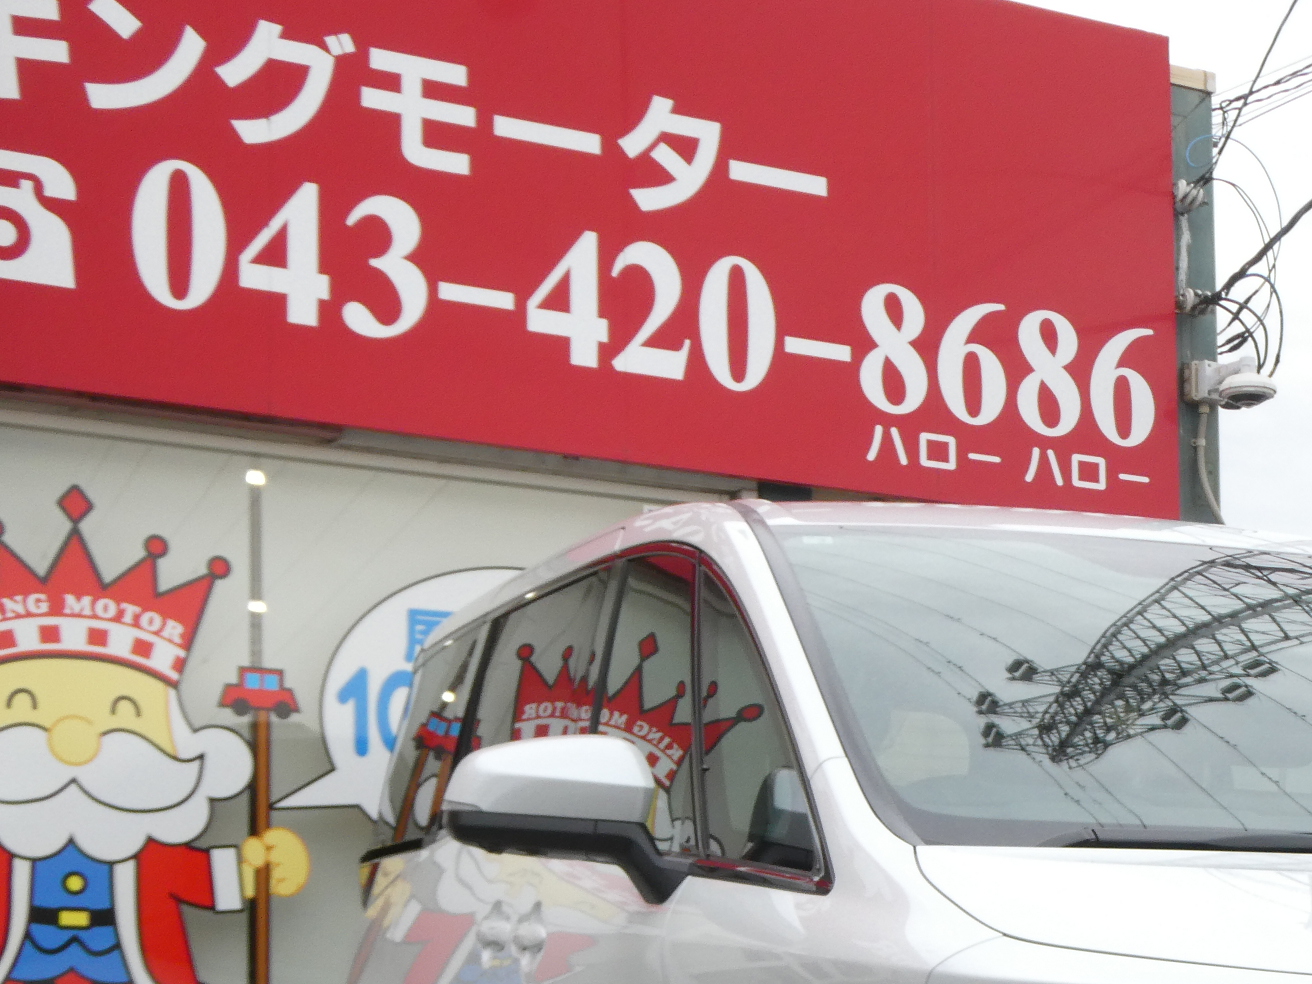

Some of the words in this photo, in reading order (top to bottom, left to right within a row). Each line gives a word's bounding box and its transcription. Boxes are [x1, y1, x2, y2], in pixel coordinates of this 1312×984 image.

[131, 158, 1156, 449] 043-420-8686
[865, 424, 1002, 471] ハロー
[1024, 446, 1150, 491] ハロー
[0, 592, 50, 619] NG
[62, 593, 186, 644] MOTOR
